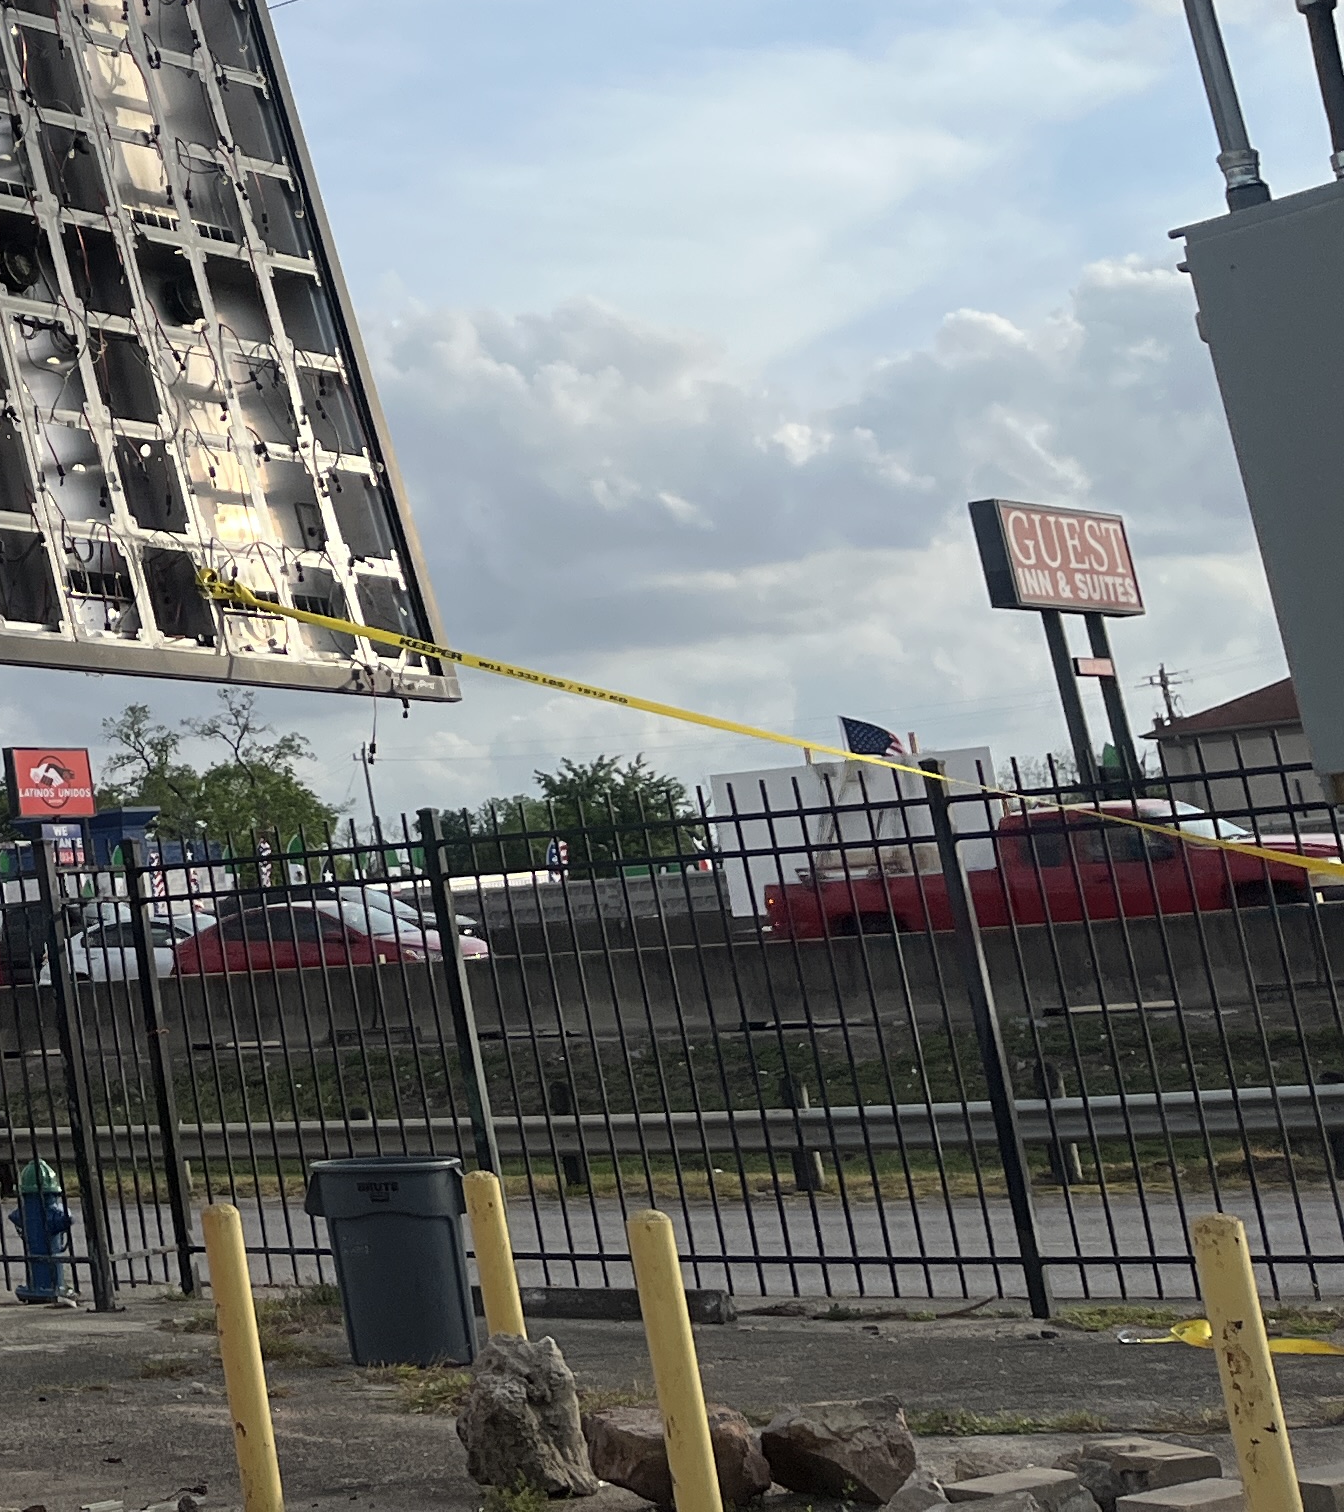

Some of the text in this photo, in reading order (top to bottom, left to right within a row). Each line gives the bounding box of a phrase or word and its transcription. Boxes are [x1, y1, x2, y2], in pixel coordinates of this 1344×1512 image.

[1007, 510, 1127, 574] GUEST
[1017, 567, 1138, 604] INN & SUITES
[398, 637, 463, 662] KEEPER
[18, 787, 92, 798] LATINOS UNIDOS
[52, 826, 68, 836] WE
[356, 1181, 399, 1192] BRUTE
